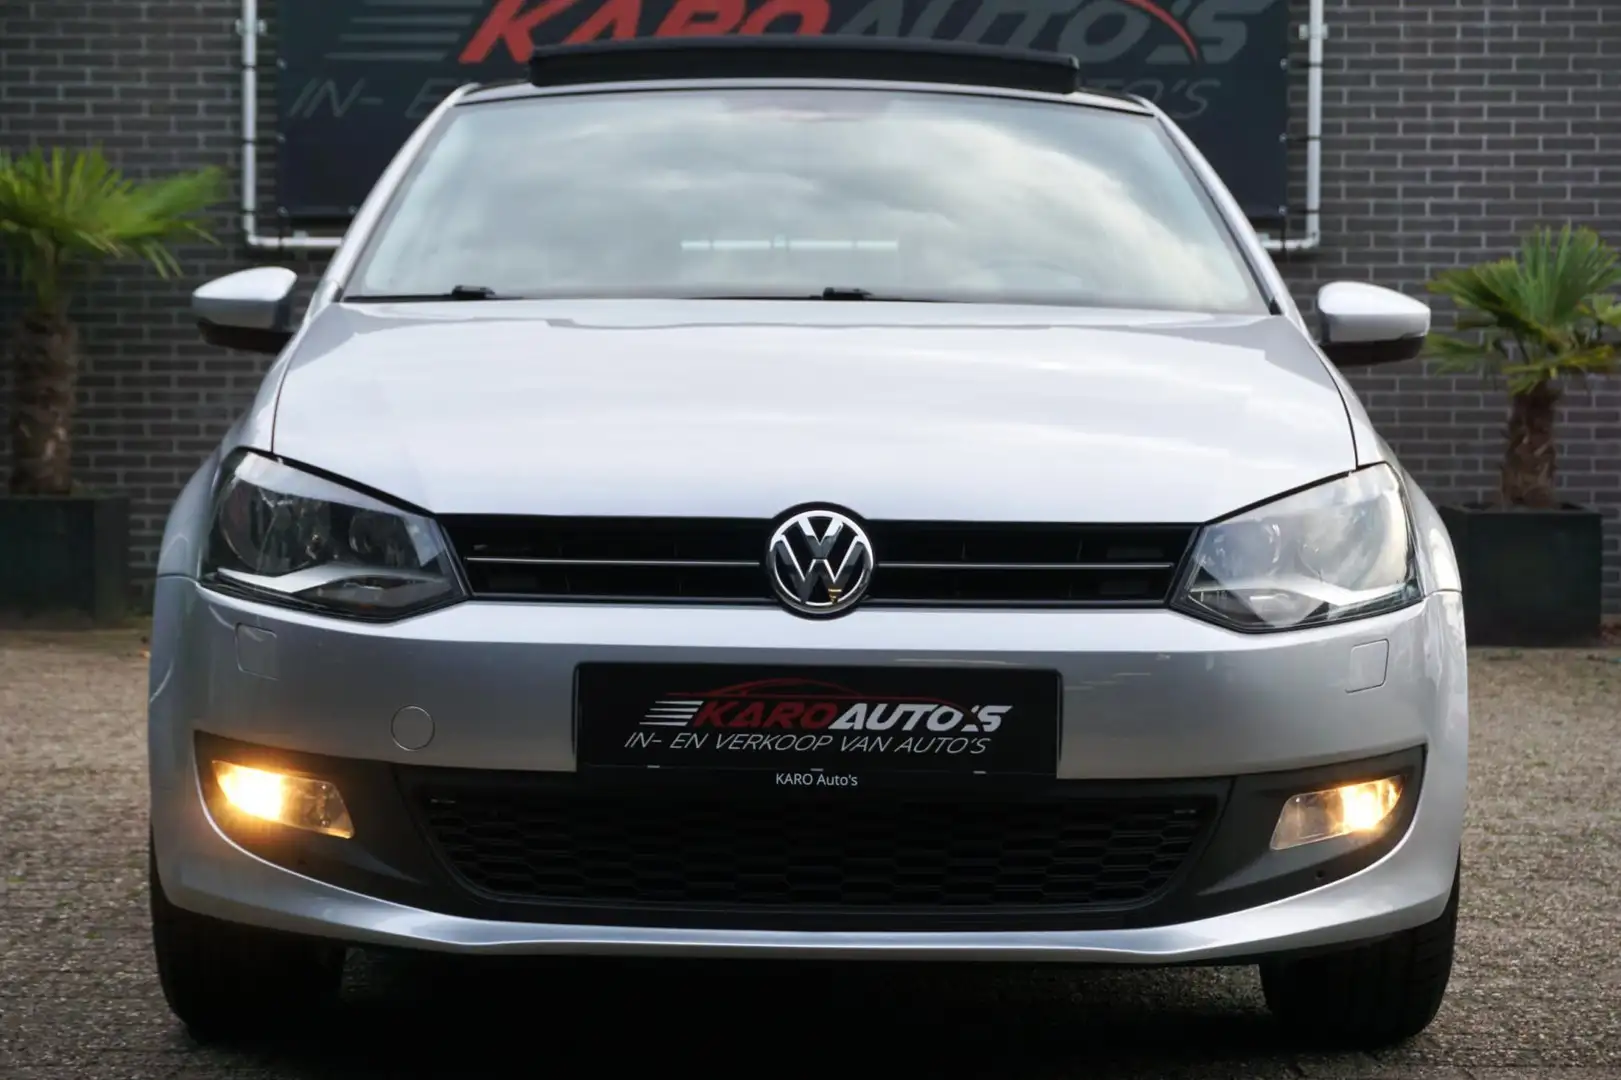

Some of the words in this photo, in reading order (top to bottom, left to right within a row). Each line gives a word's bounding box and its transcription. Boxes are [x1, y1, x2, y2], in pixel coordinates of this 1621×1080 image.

[624, 732, 662, 749] IN-
[669, 732, 709, 749] EN
[715, 733, 834, 751] VERKOOP
[840, 735, 894, 752] VAN
[893, 736, 992, 754] AUTO'S
[775, 773, 813, 786] KARO
[816, 773, 858, 786] Auto's
